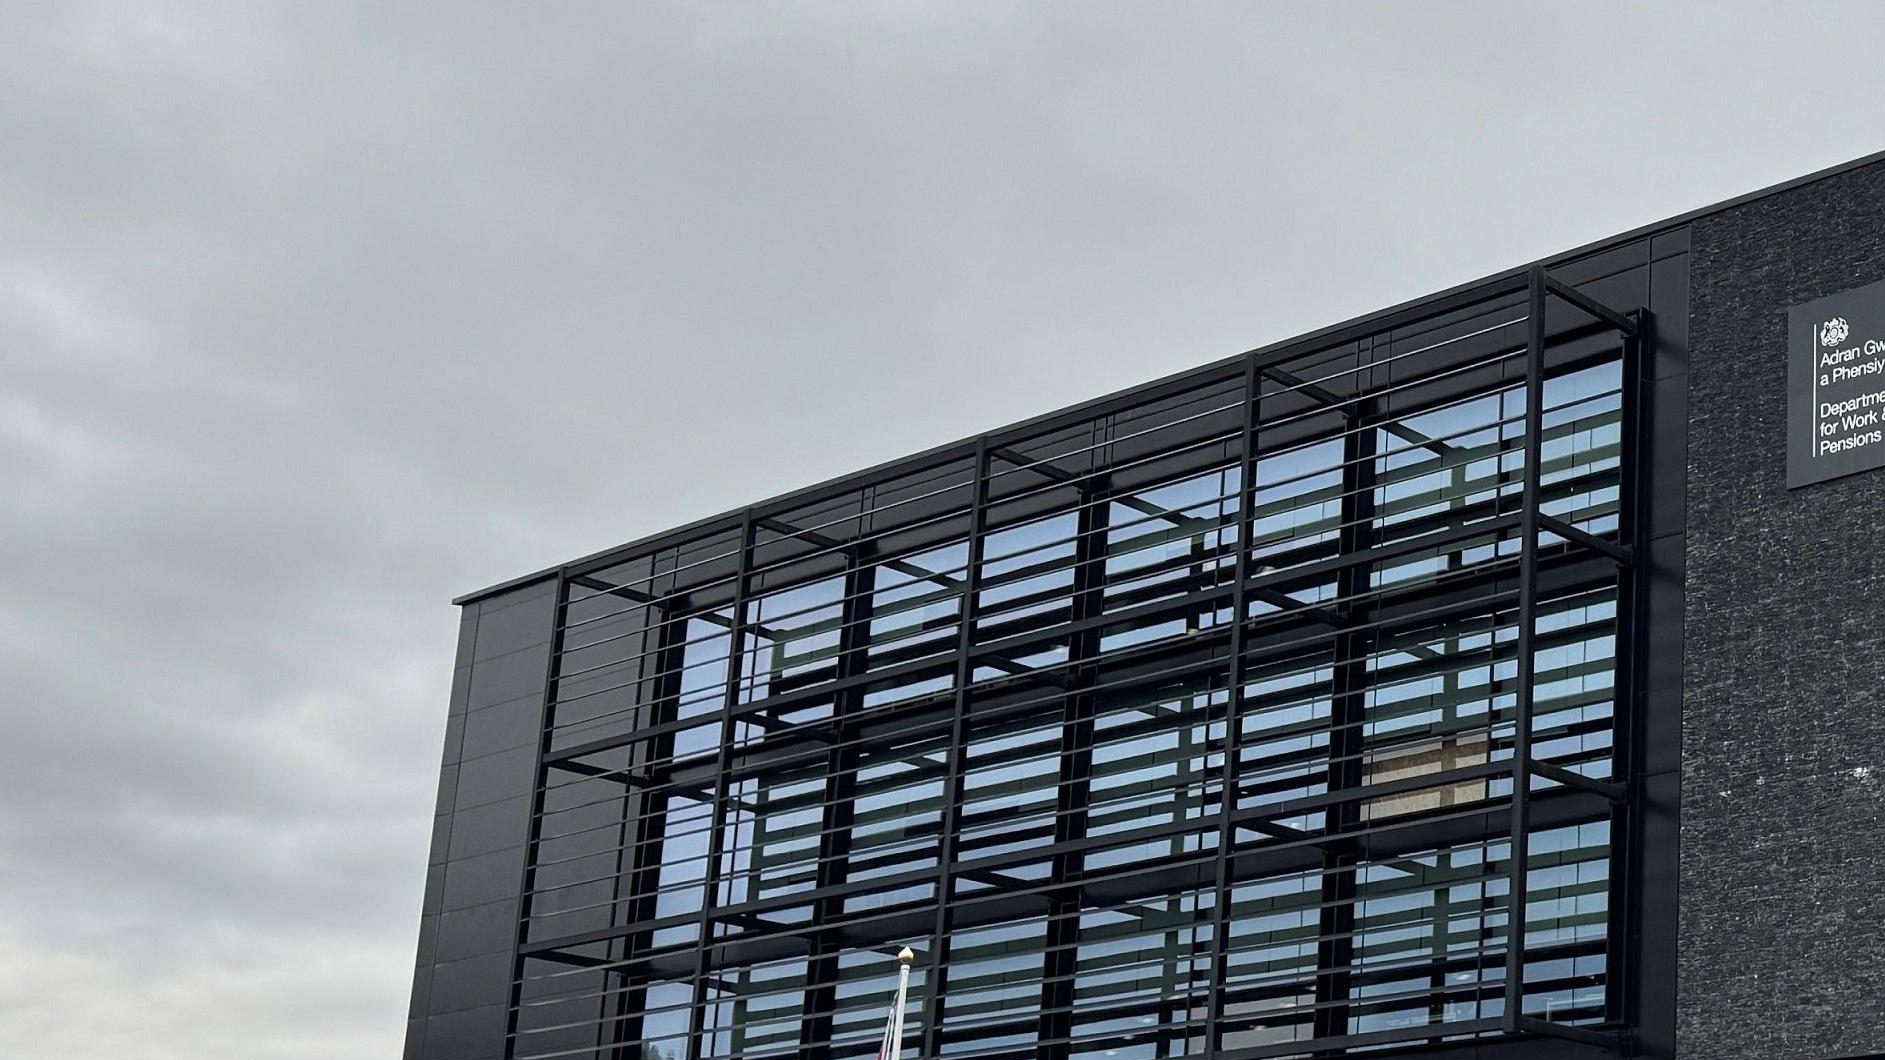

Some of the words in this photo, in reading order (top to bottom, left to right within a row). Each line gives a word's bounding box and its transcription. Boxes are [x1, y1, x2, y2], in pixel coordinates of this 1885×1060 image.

[1820, 347, 1860, 368] Adran
[1820, 374, 1829, 386] a
[1820, 421, 1839, 437] for
[1841, 410, 1878, 431] Work
[1820, 430, 1882, 456] Pensions
